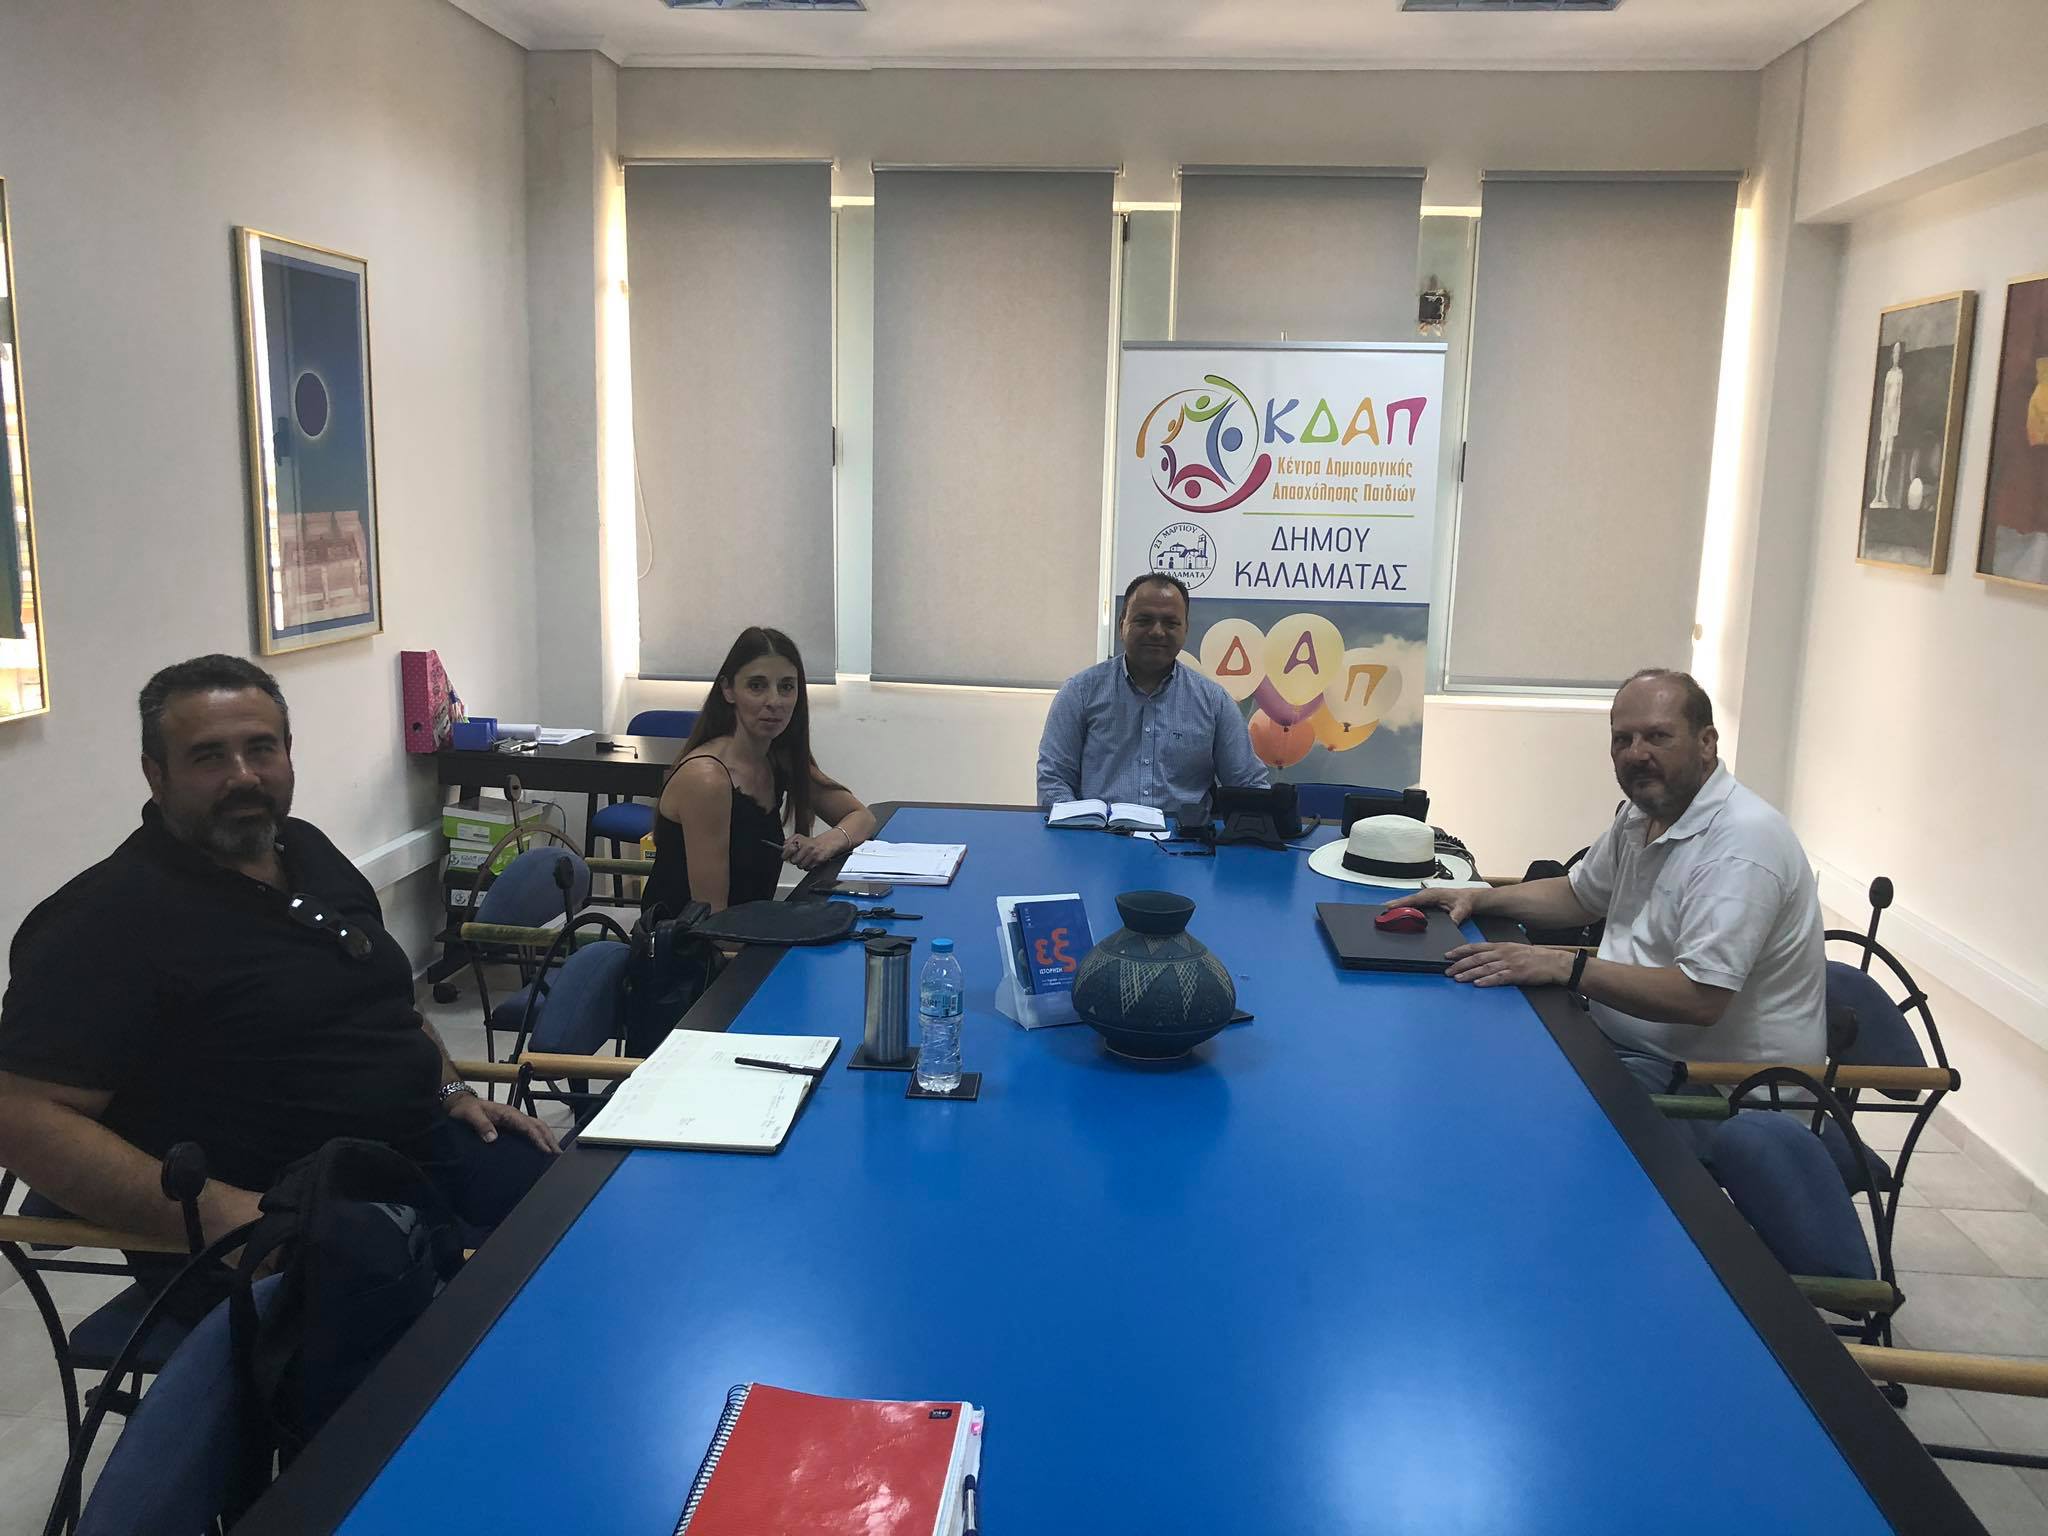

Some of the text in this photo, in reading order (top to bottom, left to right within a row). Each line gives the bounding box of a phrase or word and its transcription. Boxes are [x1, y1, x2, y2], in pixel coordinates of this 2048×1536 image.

[1263, 396, 1428, 446] ΚΔΑΠ
[1277, 455, 1413, 478] Κέντρα Δημιουργικής
[1272, 482, 1416, 503] Απασχόλησης Παιδιών
[1162, 525, 1198, 538] ΜΑΡΤΙΟΥ
[1271, 526, 1371, 553] ΔΗΜΟΥ
[1235, 561, 1408, 591] ΚΑΛΑΜΑΤΑΣ
